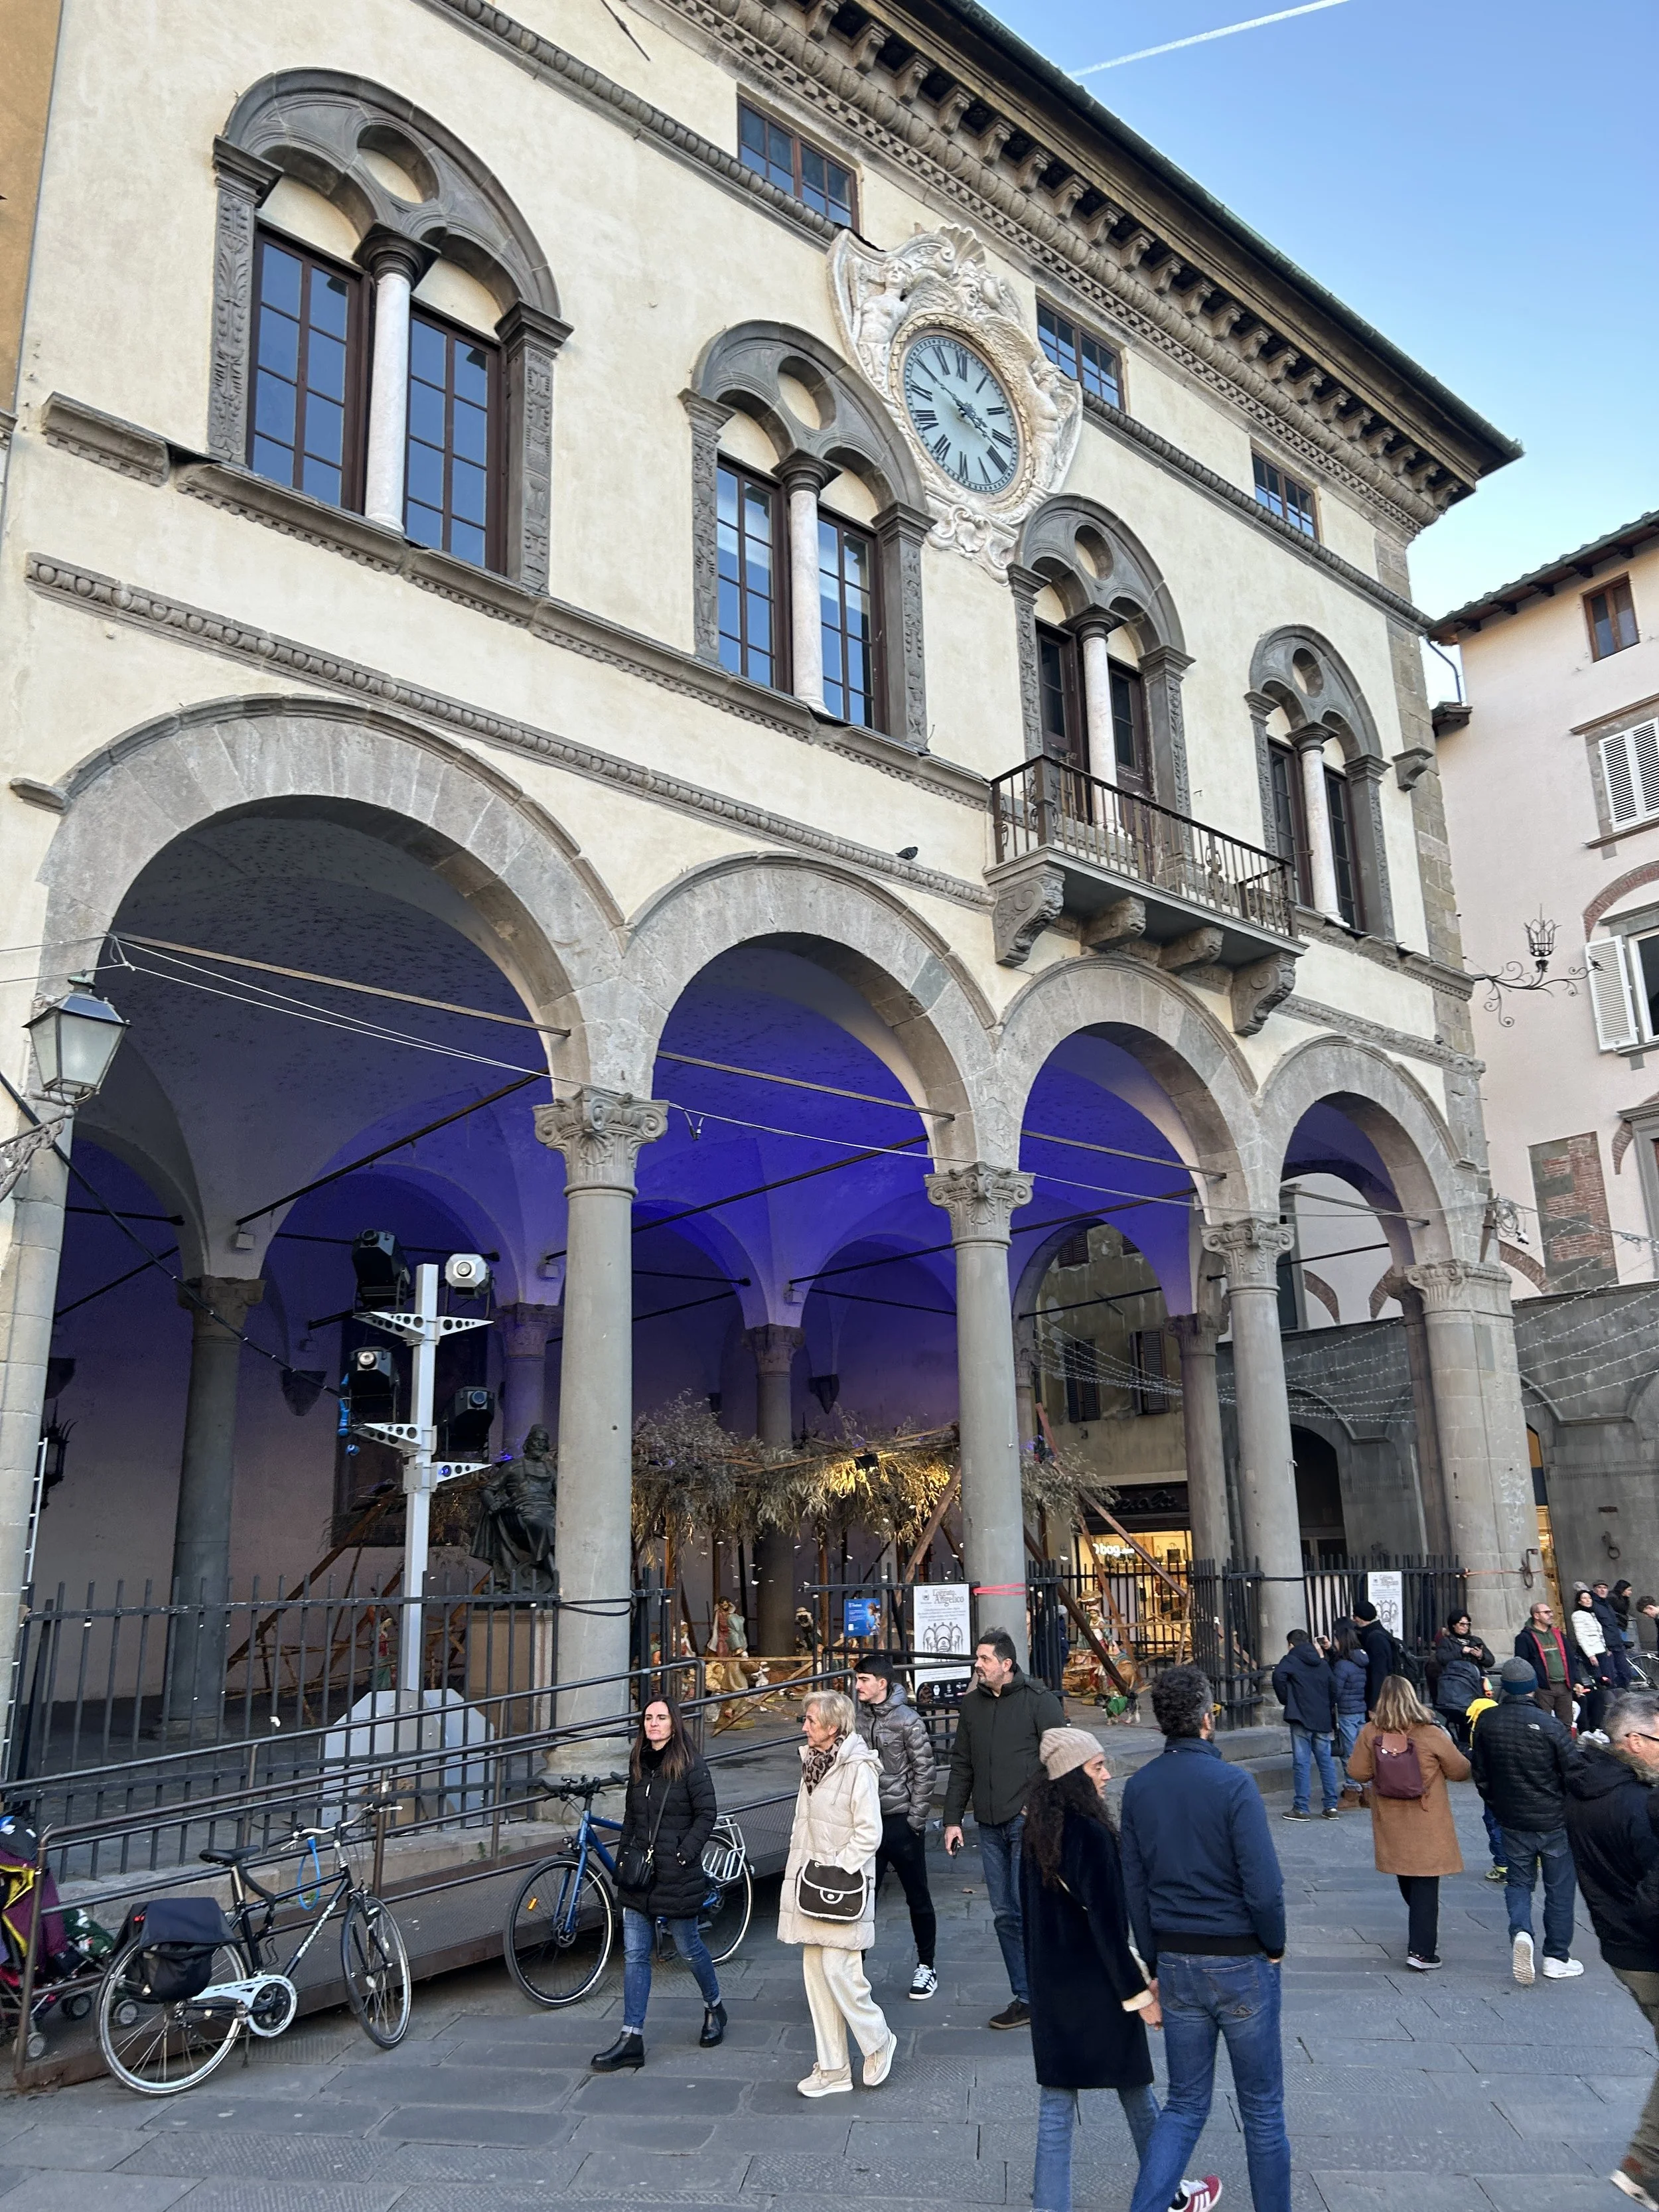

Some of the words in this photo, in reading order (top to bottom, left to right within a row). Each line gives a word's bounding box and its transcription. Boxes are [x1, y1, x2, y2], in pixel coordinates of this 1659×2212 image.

[915, 409, 939, 431] VIII
[986, 406, 1007, 415] II
[934, 433, 951, 461] VII
[991, 428, 1013, 449] III
